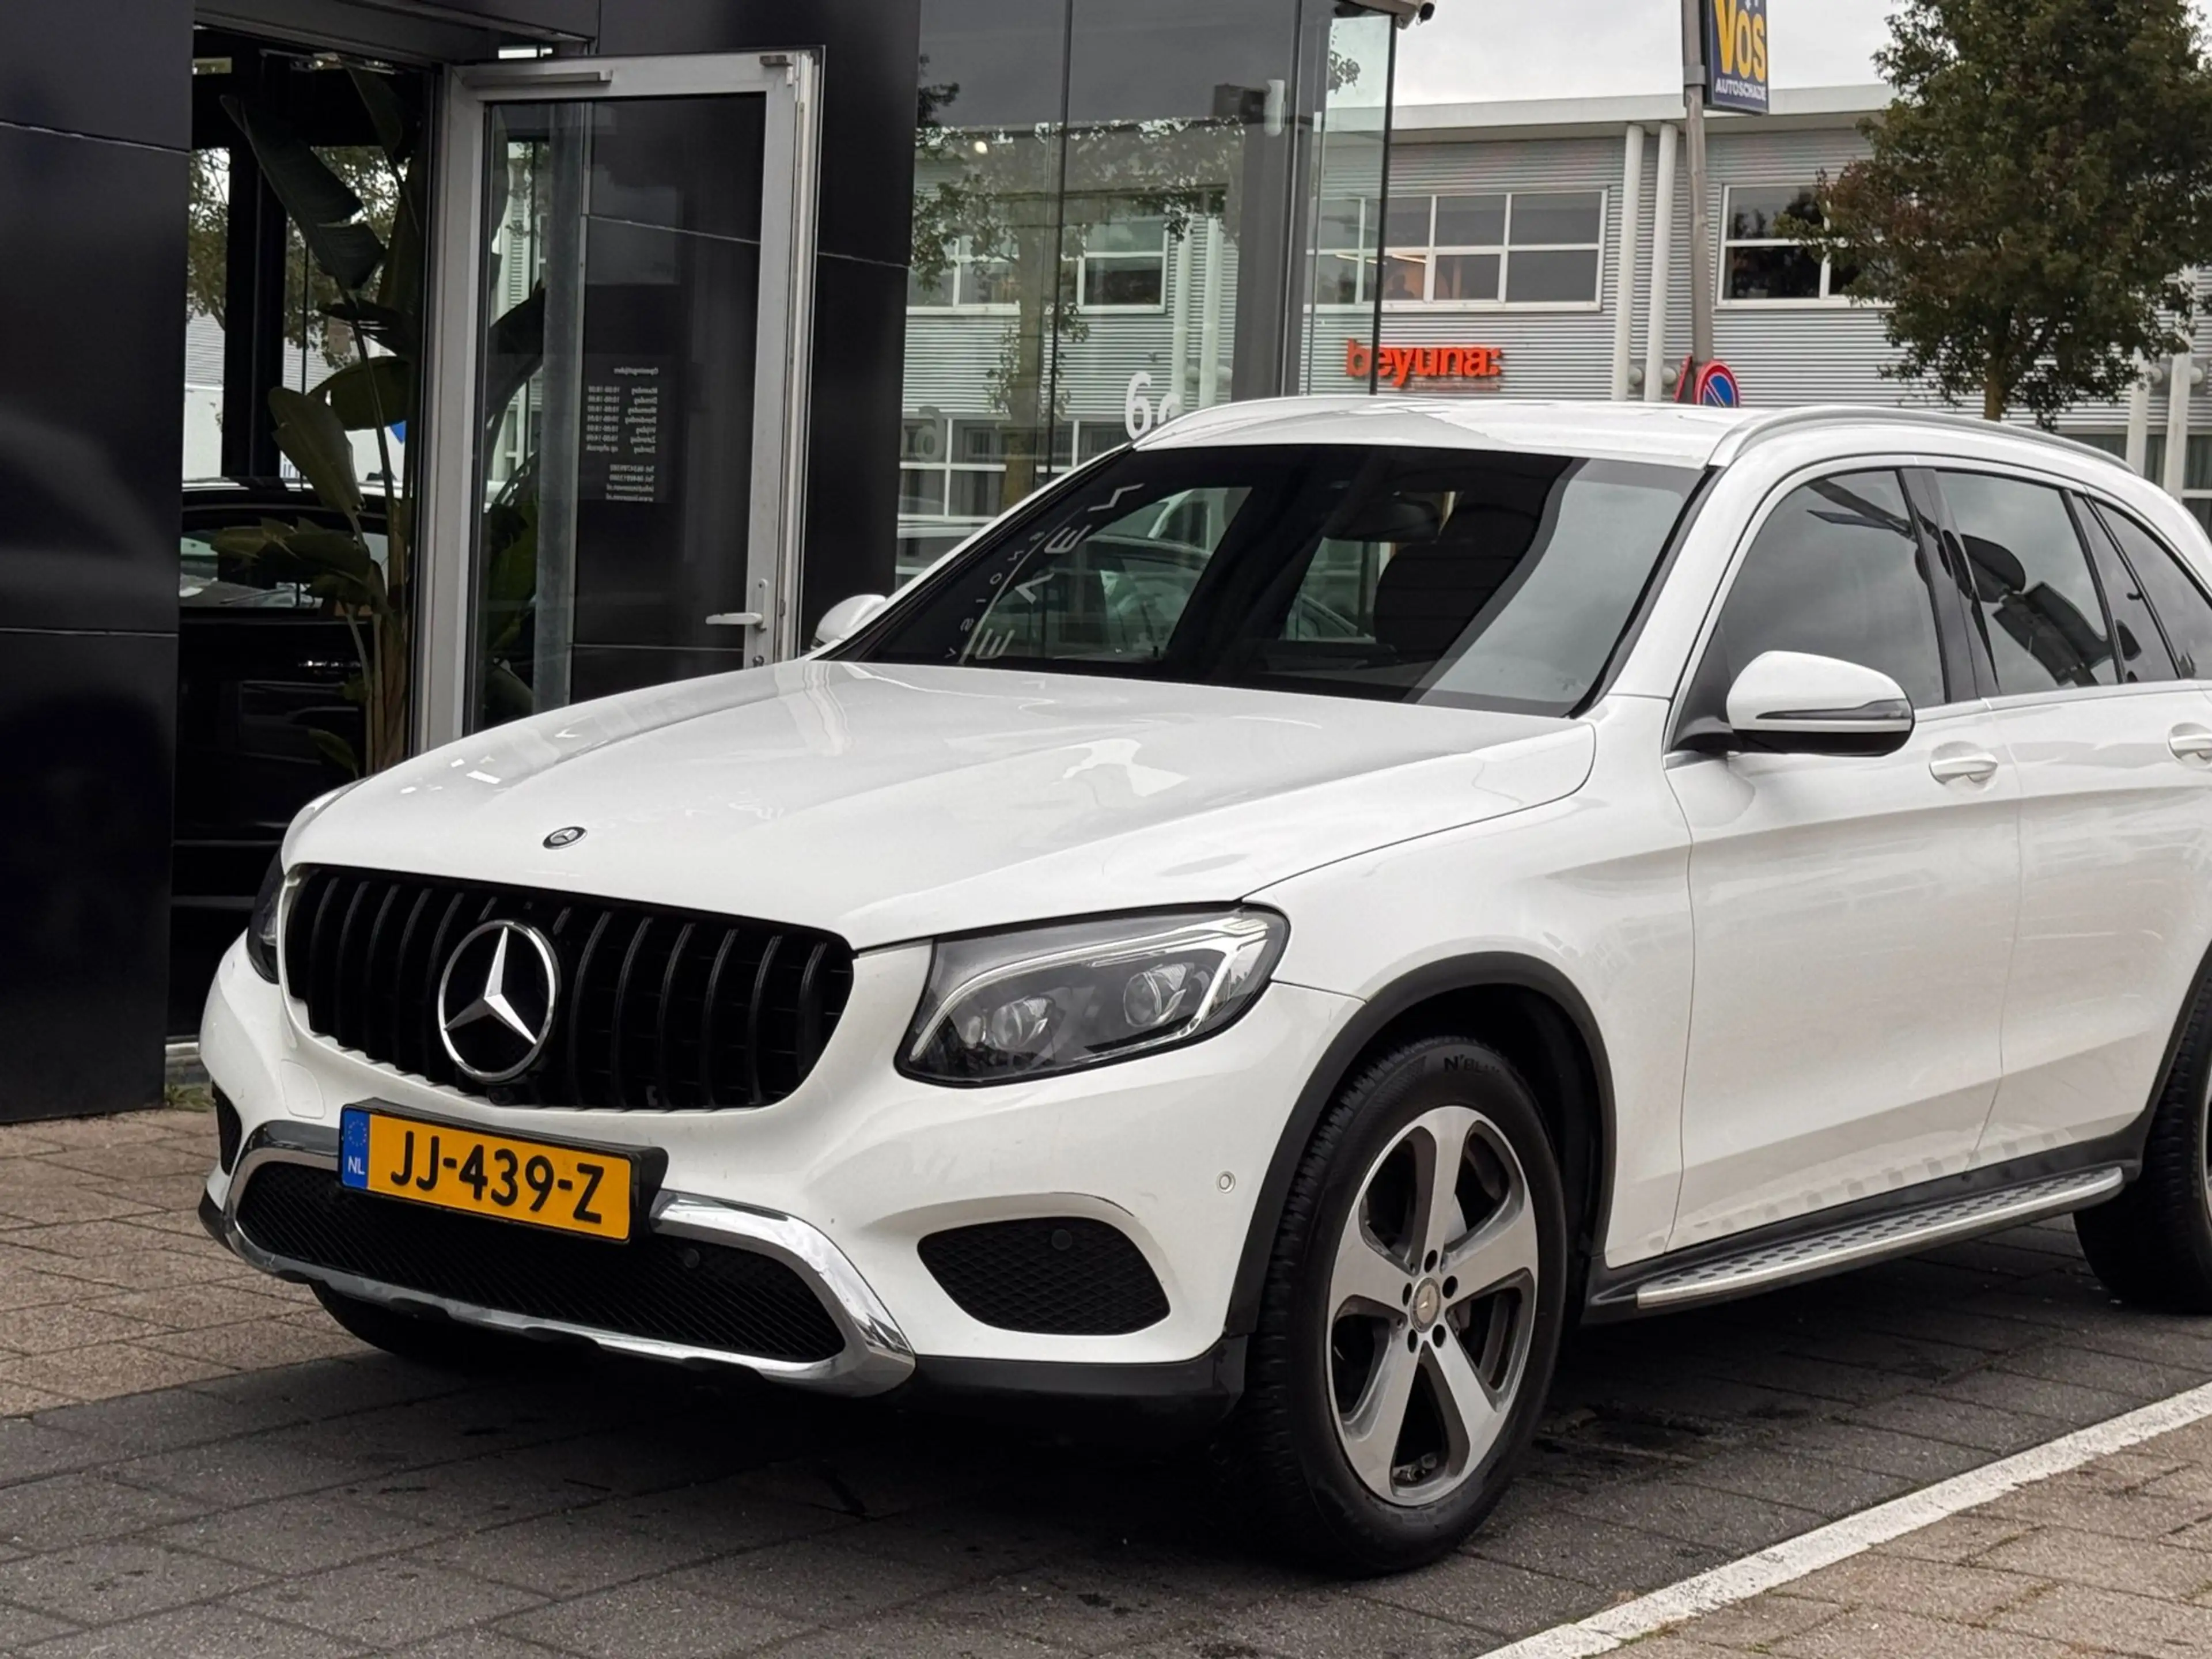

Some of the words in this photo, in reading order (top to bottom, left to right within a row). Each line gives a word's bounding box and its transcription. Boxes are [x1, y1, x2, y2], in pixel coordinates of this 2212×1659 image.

[1715, 77, 1766, 101] AUTOSCHADE
[347, 1156, 365, 1176] NL
[391, 1130, 604, 1225] JJ-439-Z
